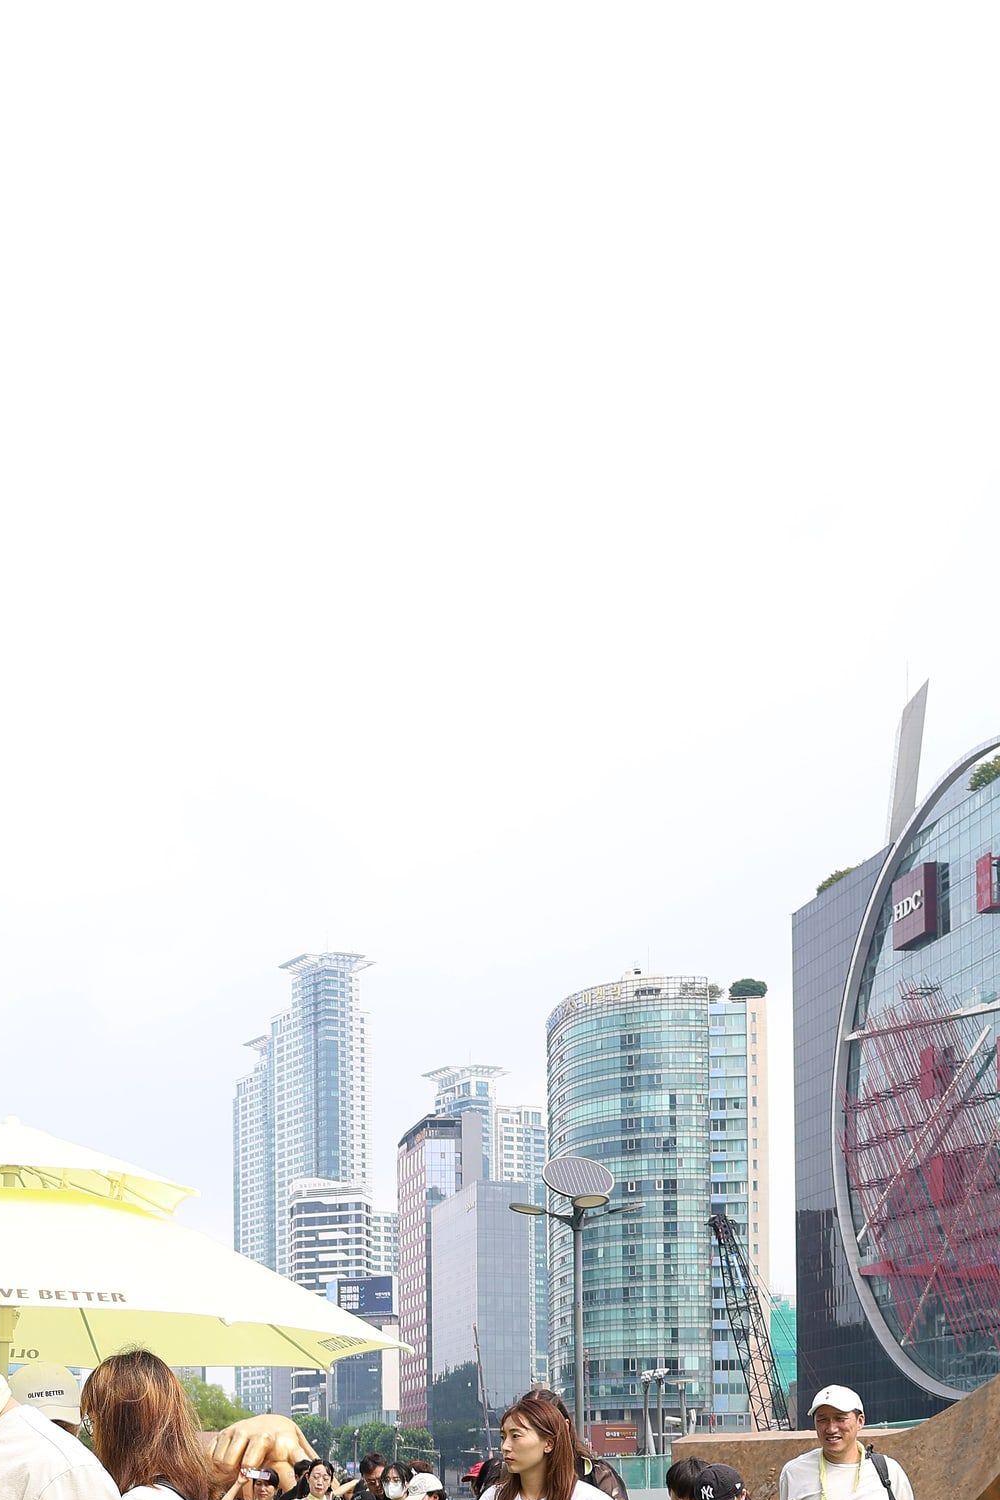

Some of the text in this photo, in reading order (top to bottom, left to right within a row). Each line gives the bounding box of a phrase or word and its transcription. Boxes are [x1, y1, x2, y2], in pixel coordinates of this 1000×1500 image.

[893, 889, 923, 922] HDC
[38, 1289, 127, 1303] BETTER
[45, 1389, 64, 1397] BETTER
